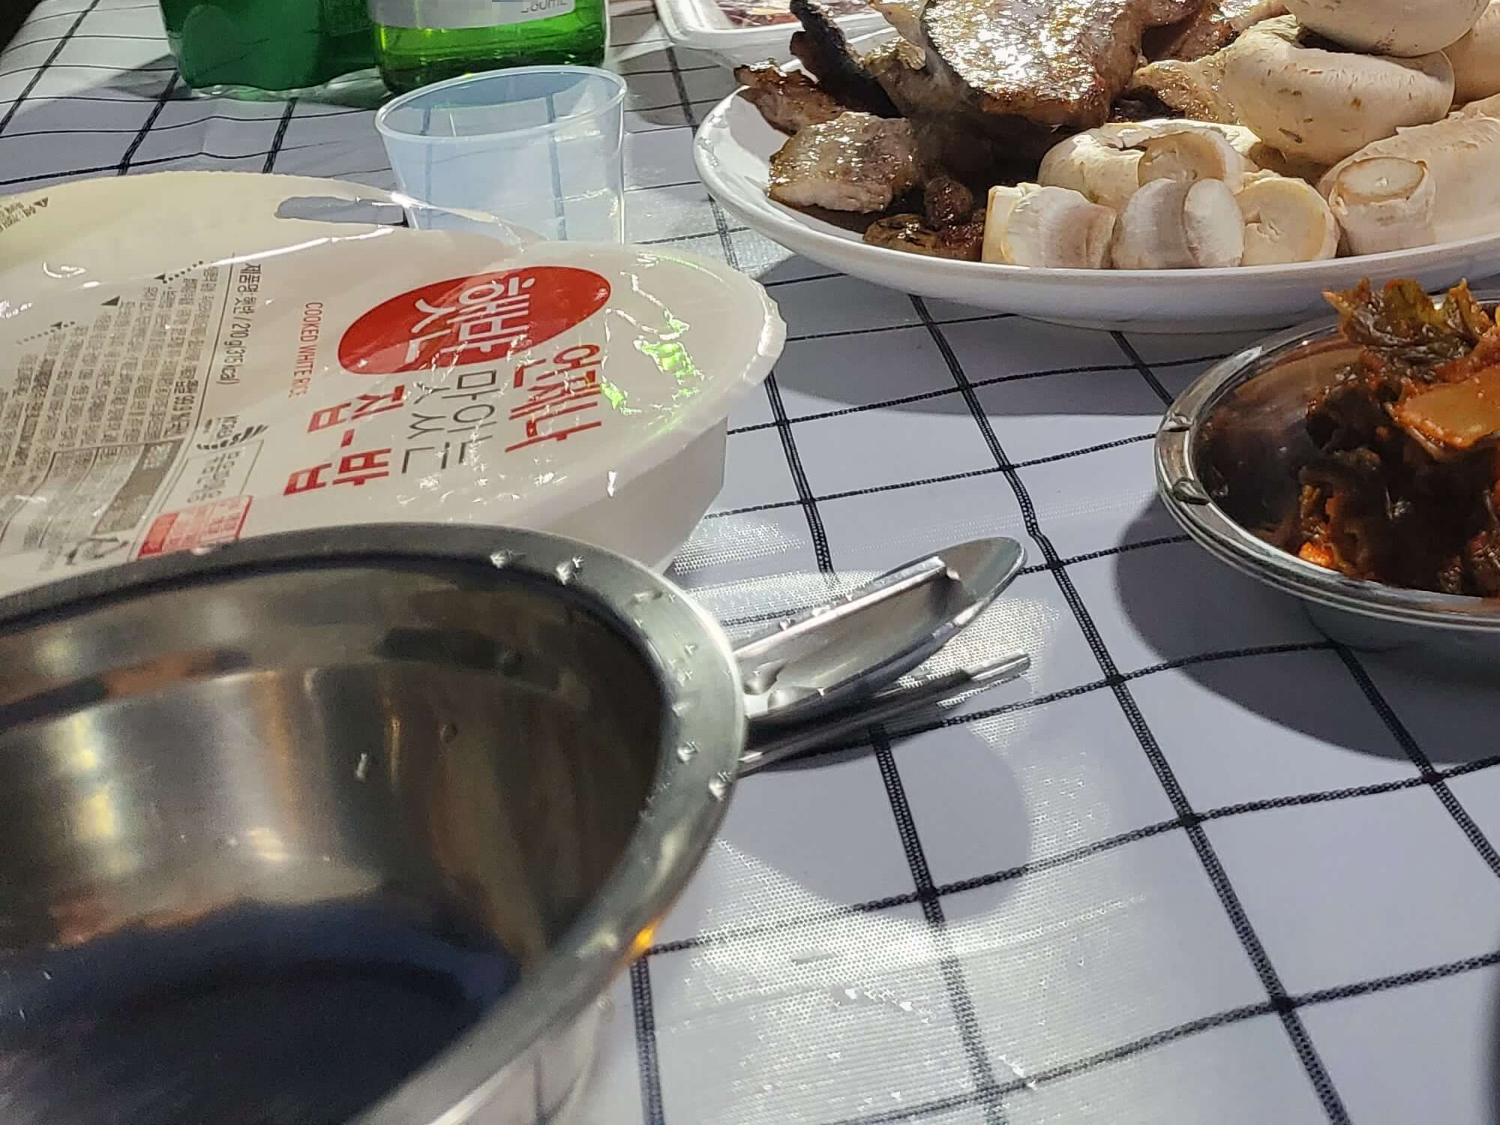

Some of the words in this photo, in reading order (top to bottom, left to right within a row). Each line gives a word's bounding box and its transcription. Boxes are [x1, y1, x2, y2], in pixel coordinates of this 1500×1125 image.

[301, 302, 323, 342] COOKED
[405, 277, 536, 365] 햇반
[293, 343, 316, 376] WHITE
[504, 344, 602, 453] 언제나
